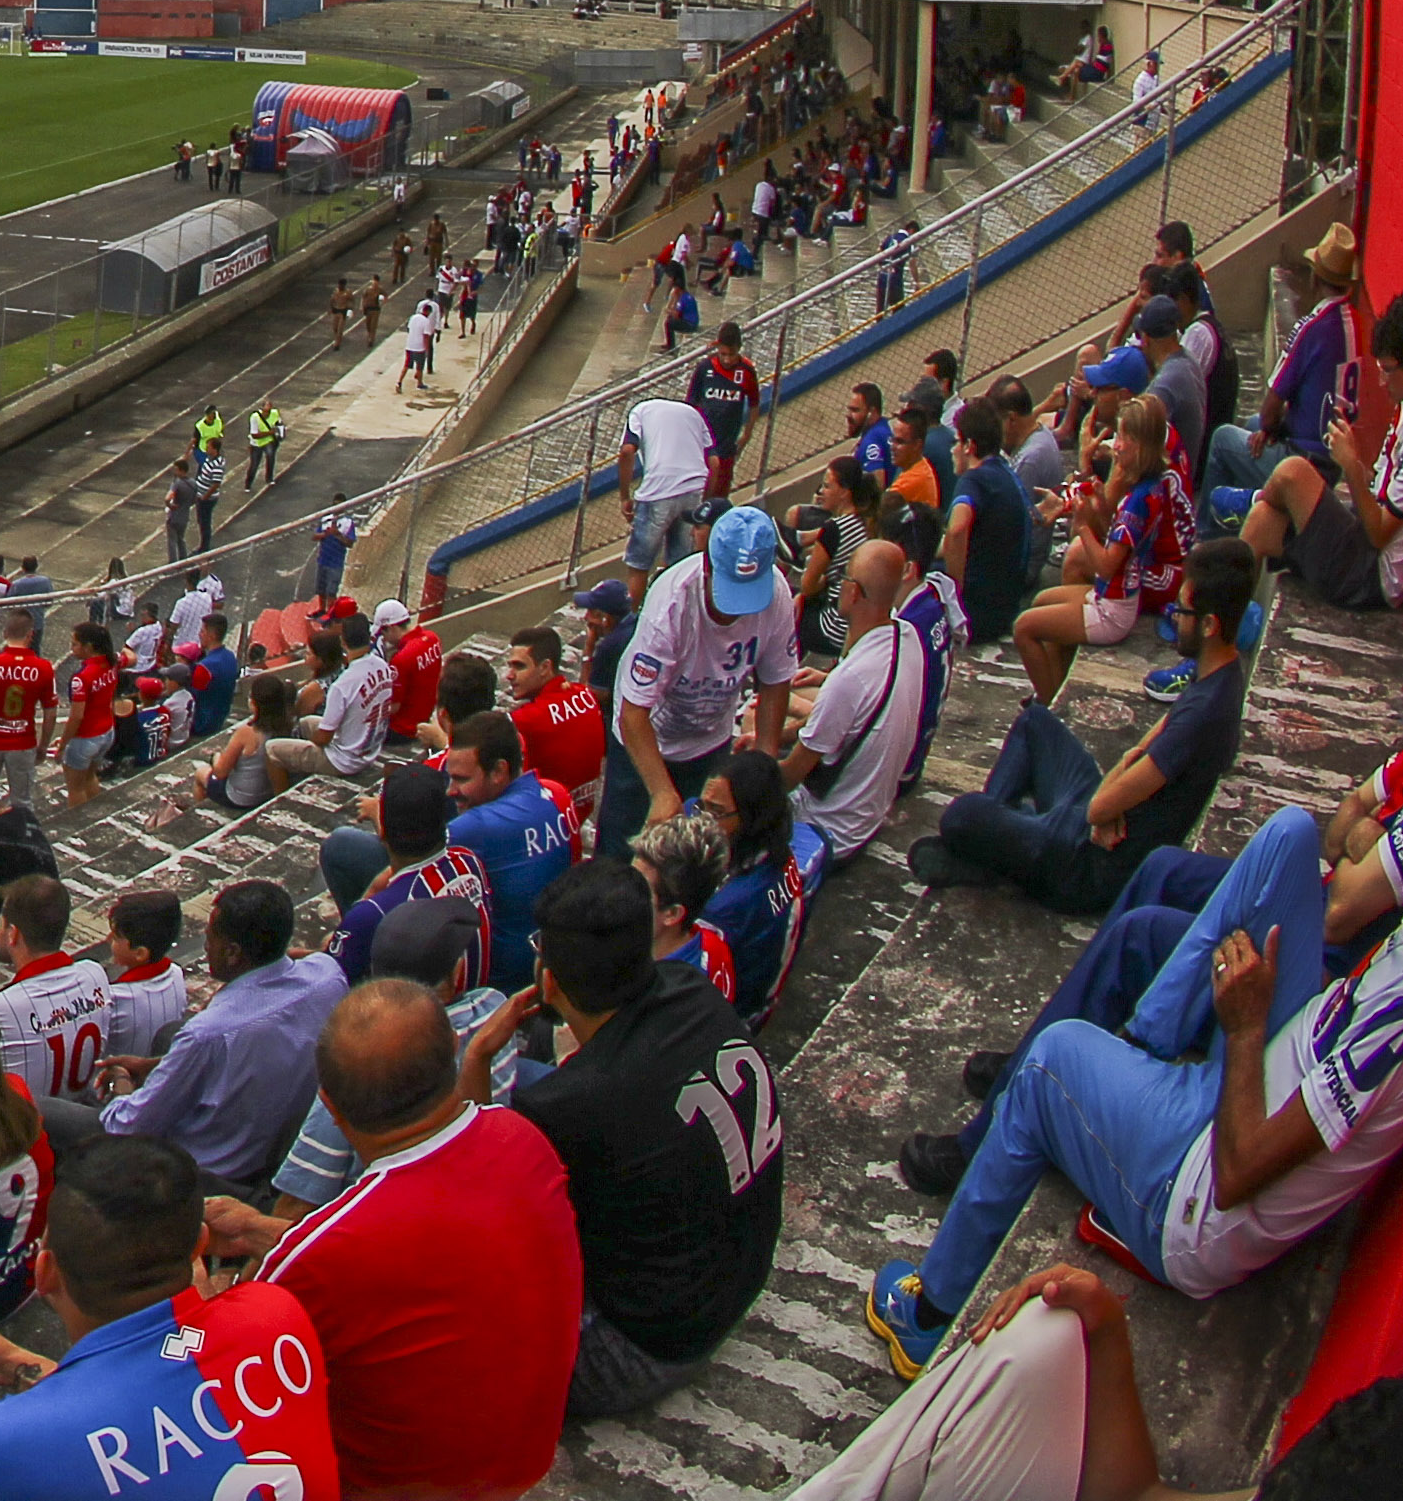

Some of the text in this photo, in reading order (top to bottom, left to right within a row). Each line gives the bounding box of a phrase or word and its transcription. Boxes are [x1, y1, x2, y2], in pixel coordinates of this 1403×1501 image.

[705, 387, 741, 401] CAIXA
[722, 636, 758, 671] 31
[3, 684, 25, 717] 6
[47, 1021, 102, 1097] 10
[1320, 1057, 1360, 1130] POTENCIAL
[675, 1038, 782, 1196] 12
[85, 1333, 313, 1495] RACCO
